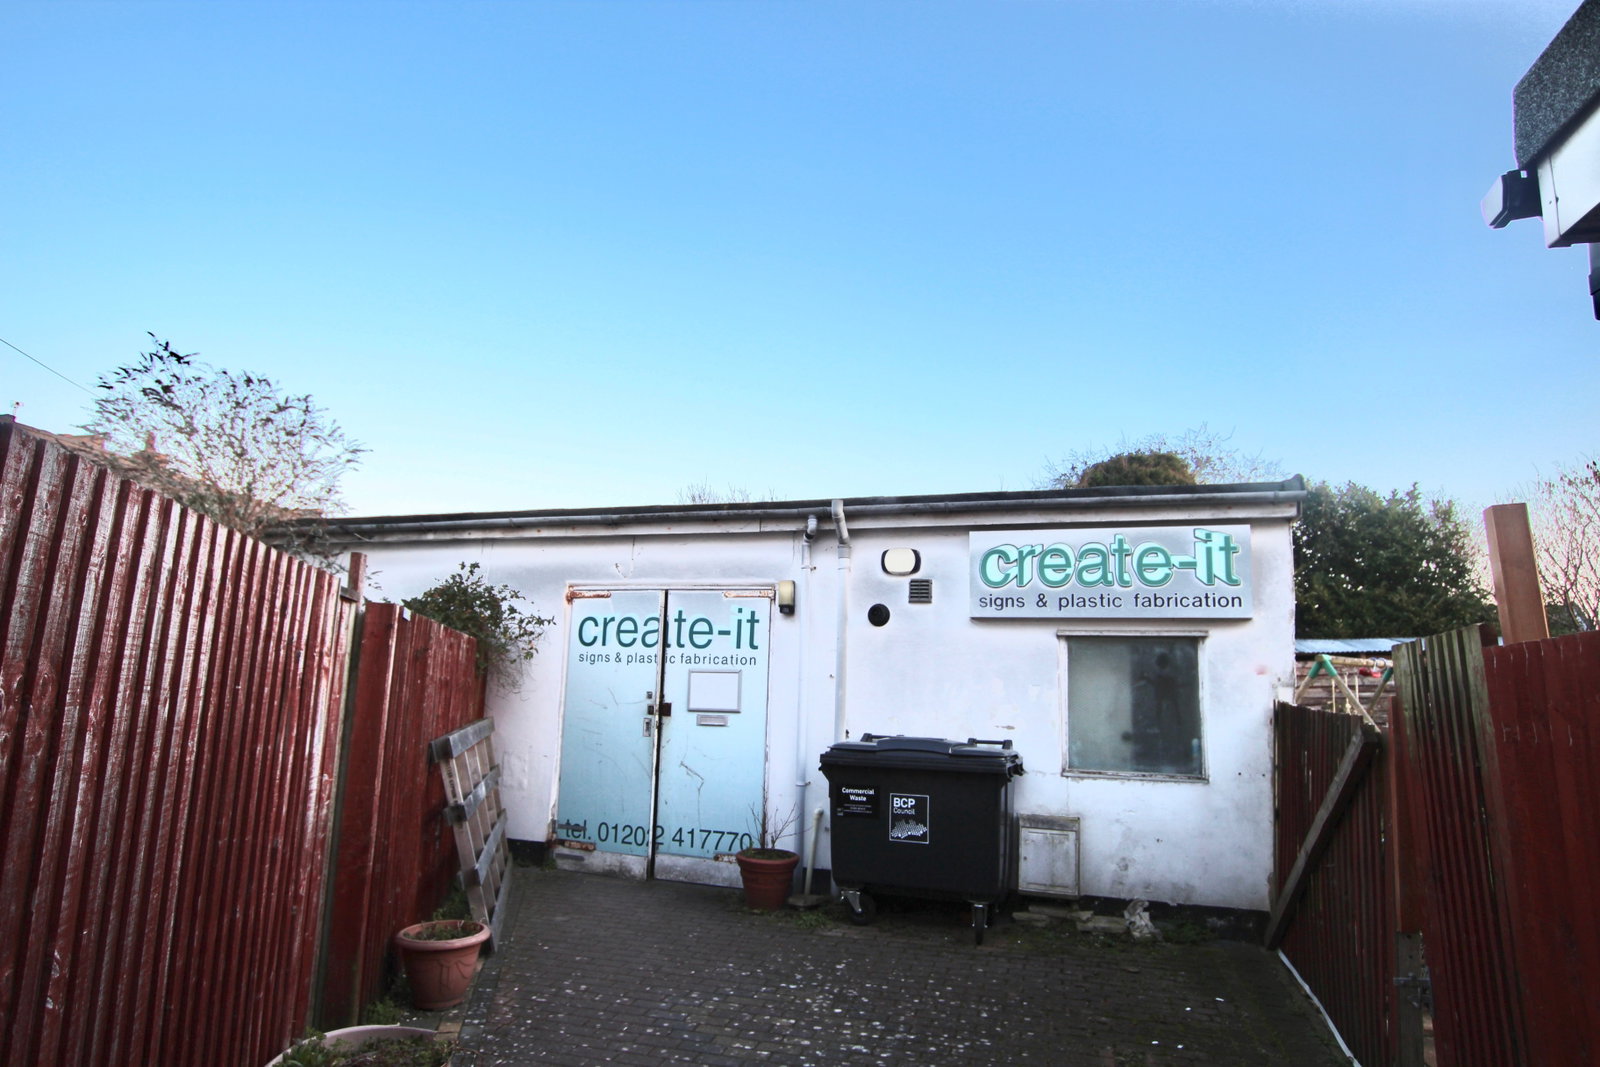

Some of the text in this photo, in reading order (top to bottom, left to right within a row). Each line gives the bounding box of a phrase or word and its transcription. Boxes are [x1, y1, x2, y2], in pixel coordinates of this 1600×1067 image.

[978, 527, 1242, 588] create-it
[979, 592, 1243, 612] signs & plastic fabrication
[578, 607, 760, 650] create-it
[578, 651, 611, 665] signs
[614, 652, 622, 663] &
[680, 652, 757, 666] fabrication
[841, 787, 875, 795] Commercial
[849, 794, 867, 802] Waste
[893, 797, 916, 808] BCP
[893, 807, 915, 815] Council
[565, 818, 591, 840] tel.
[671, 827, 753, 852] 417770
